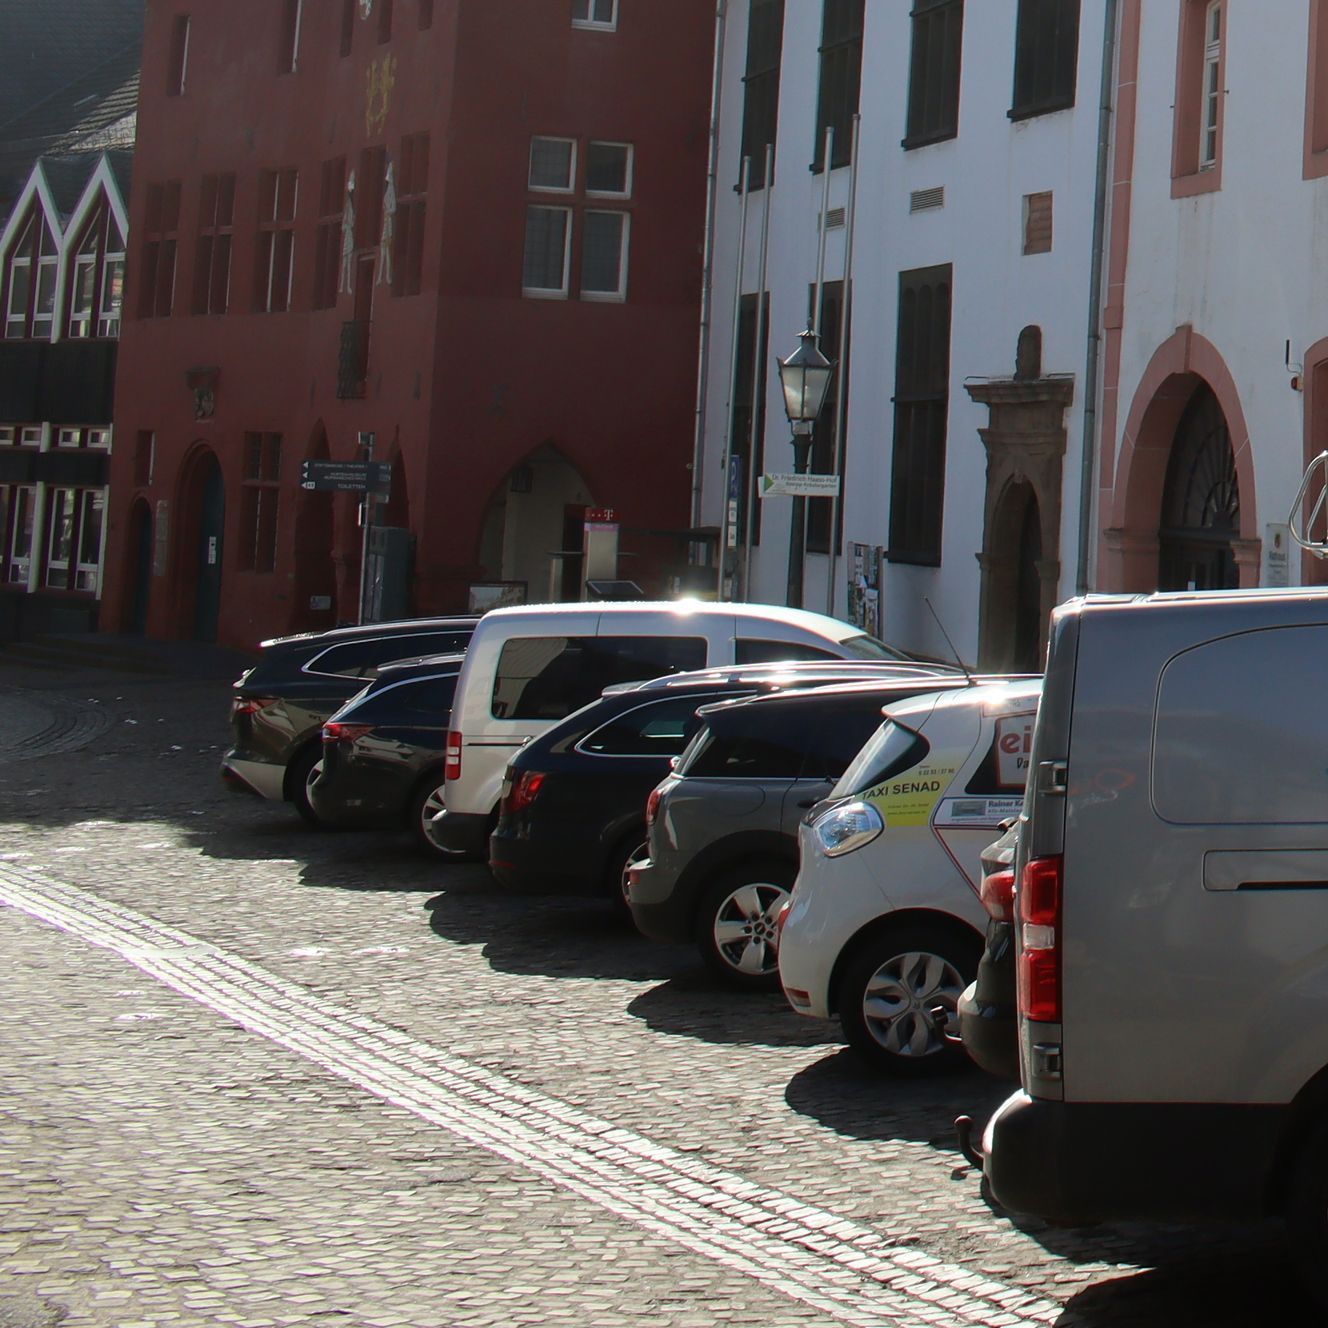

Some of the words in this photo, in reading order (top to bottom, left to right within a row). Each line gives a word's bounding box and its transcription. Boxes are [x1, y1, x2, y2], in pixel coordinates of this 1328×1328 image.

[1000, 725, 1032, 754] ei
[862, 786, 888, 800] TAXI
[892, 781, 940, 795] SENAD
